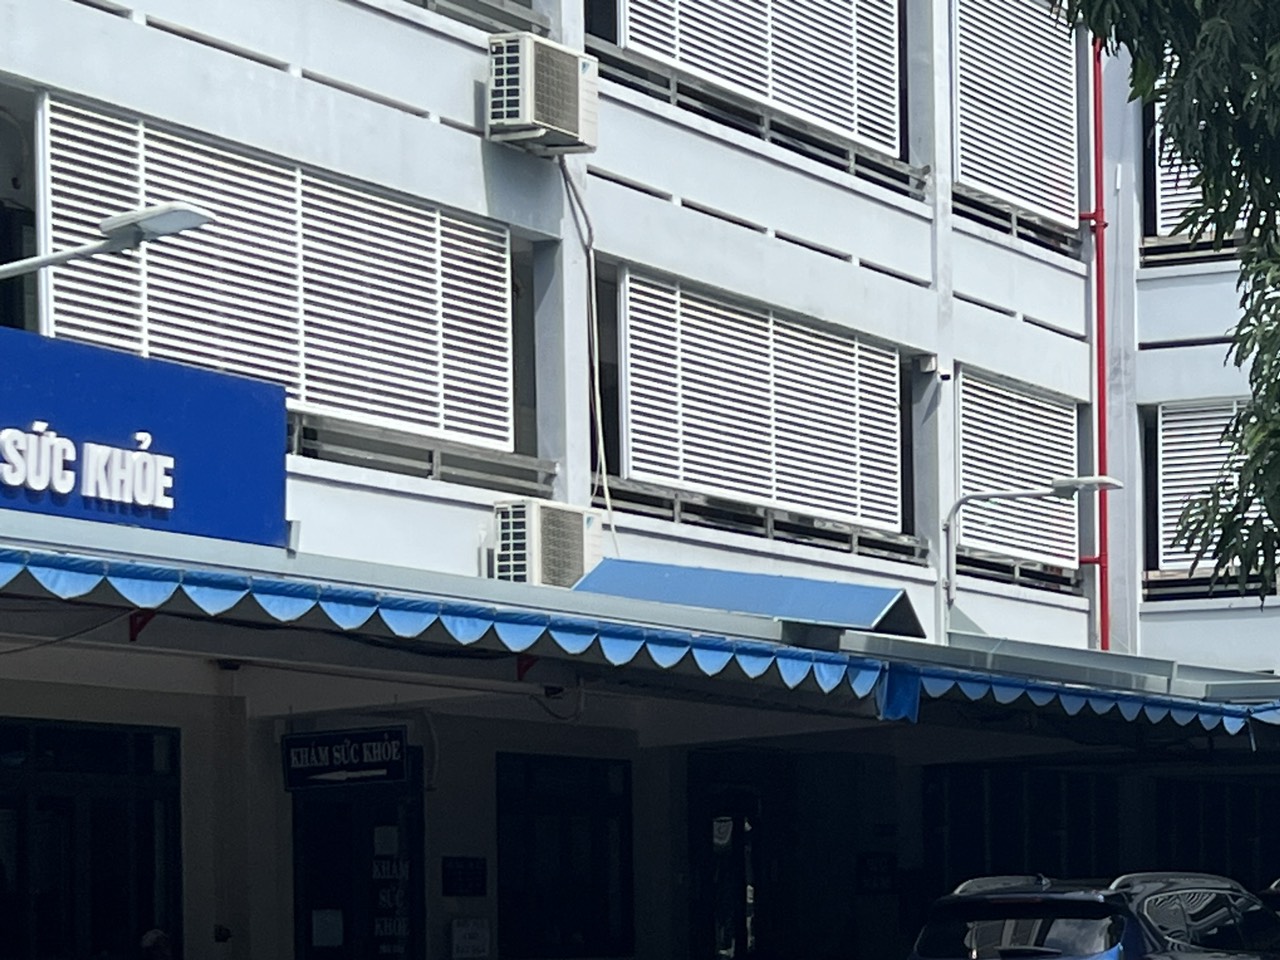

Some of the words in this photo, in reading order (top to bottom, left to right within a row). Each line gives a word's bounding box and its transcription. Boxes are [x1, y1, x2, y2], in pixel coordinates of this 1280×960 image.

[0, 421, 76, 494] SỨC
[81, 432, 174, 509] KHỎE
[290, 741, 329, 768] KHÁM
